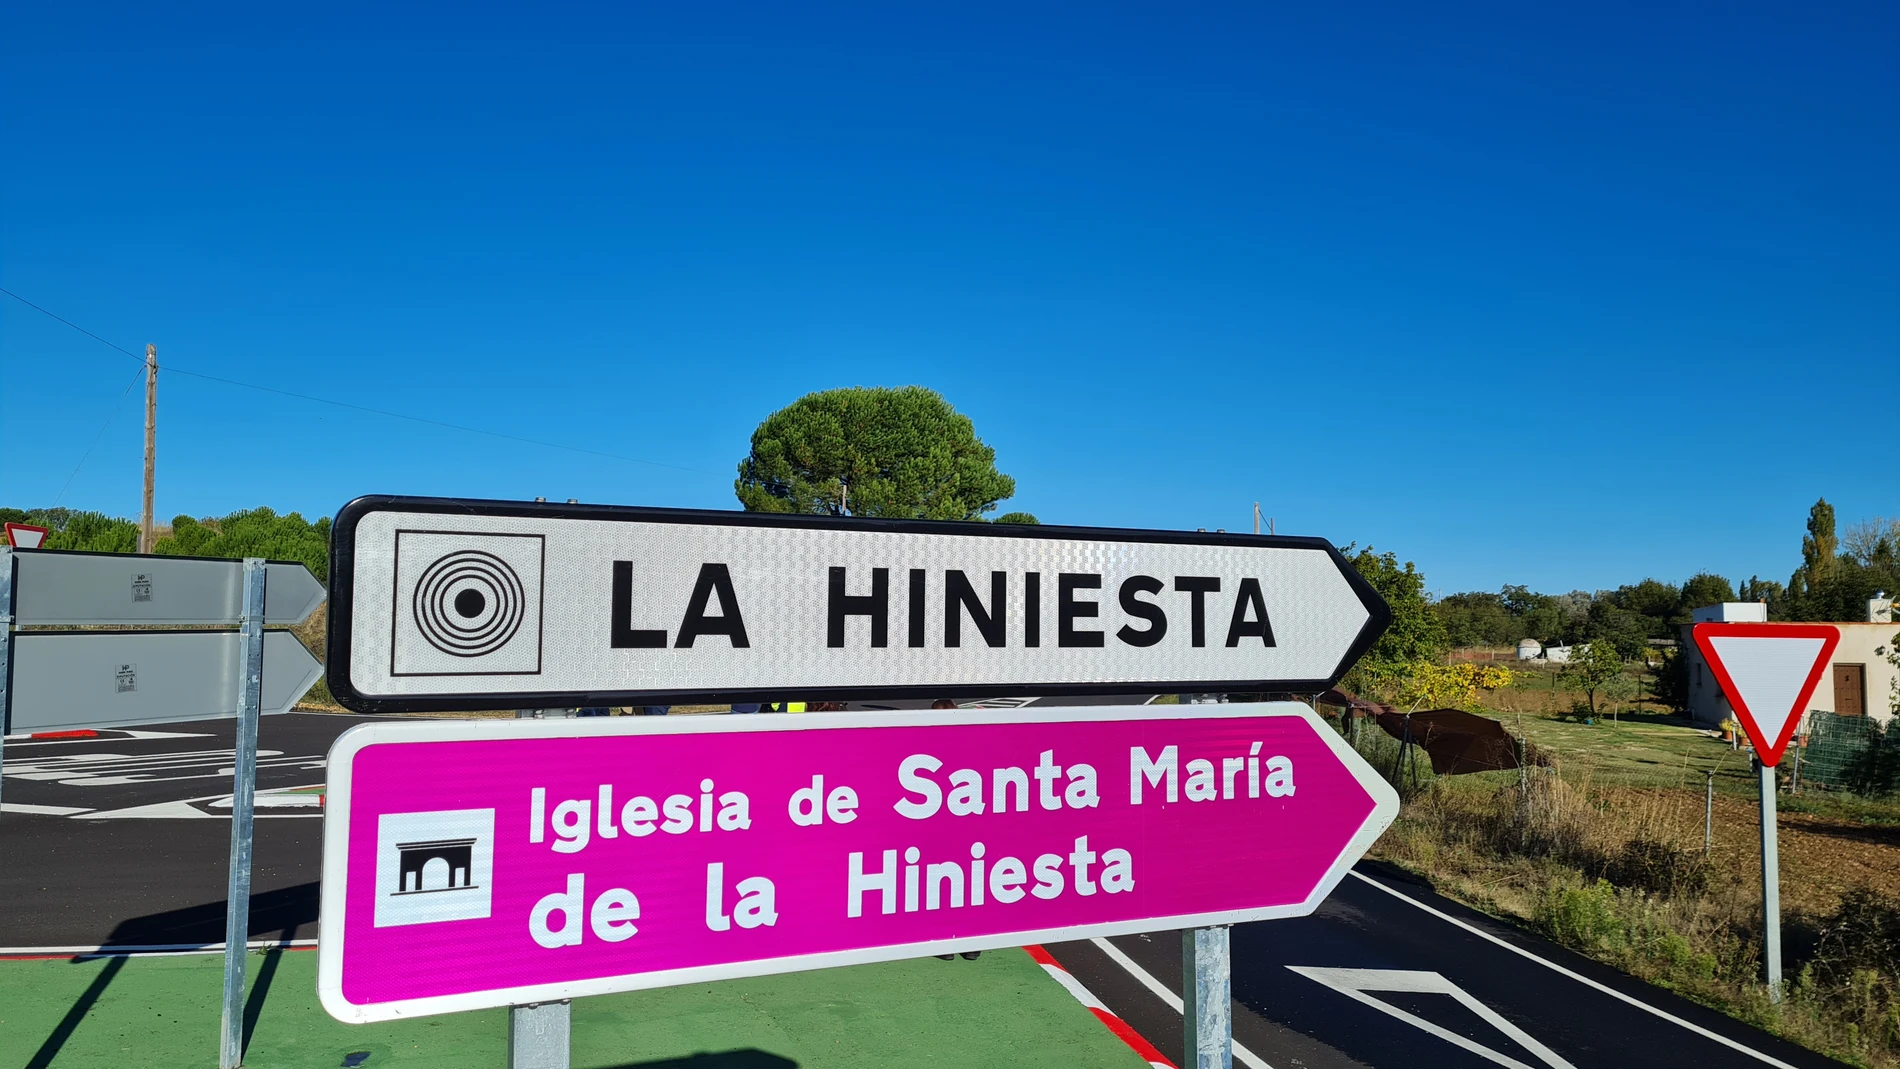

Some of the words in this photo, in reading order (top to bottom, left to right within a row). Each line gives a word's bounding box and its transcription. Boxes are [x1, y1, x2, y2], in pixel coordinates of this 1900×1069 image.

[610, 560, 751, 649] LA
[826, 566, 1277, 649] HINIESTA
[529, 778, 752, 854] Iglesia
[787, 774, 859, 827] de
[893, 749, 1101, 820] Santa
[1130, 741, 1297, 805] María
[528, 872, 641, 949] de
[705, 861, 779, 932] la
[847, 834, 1136, 918] Hiniesta
